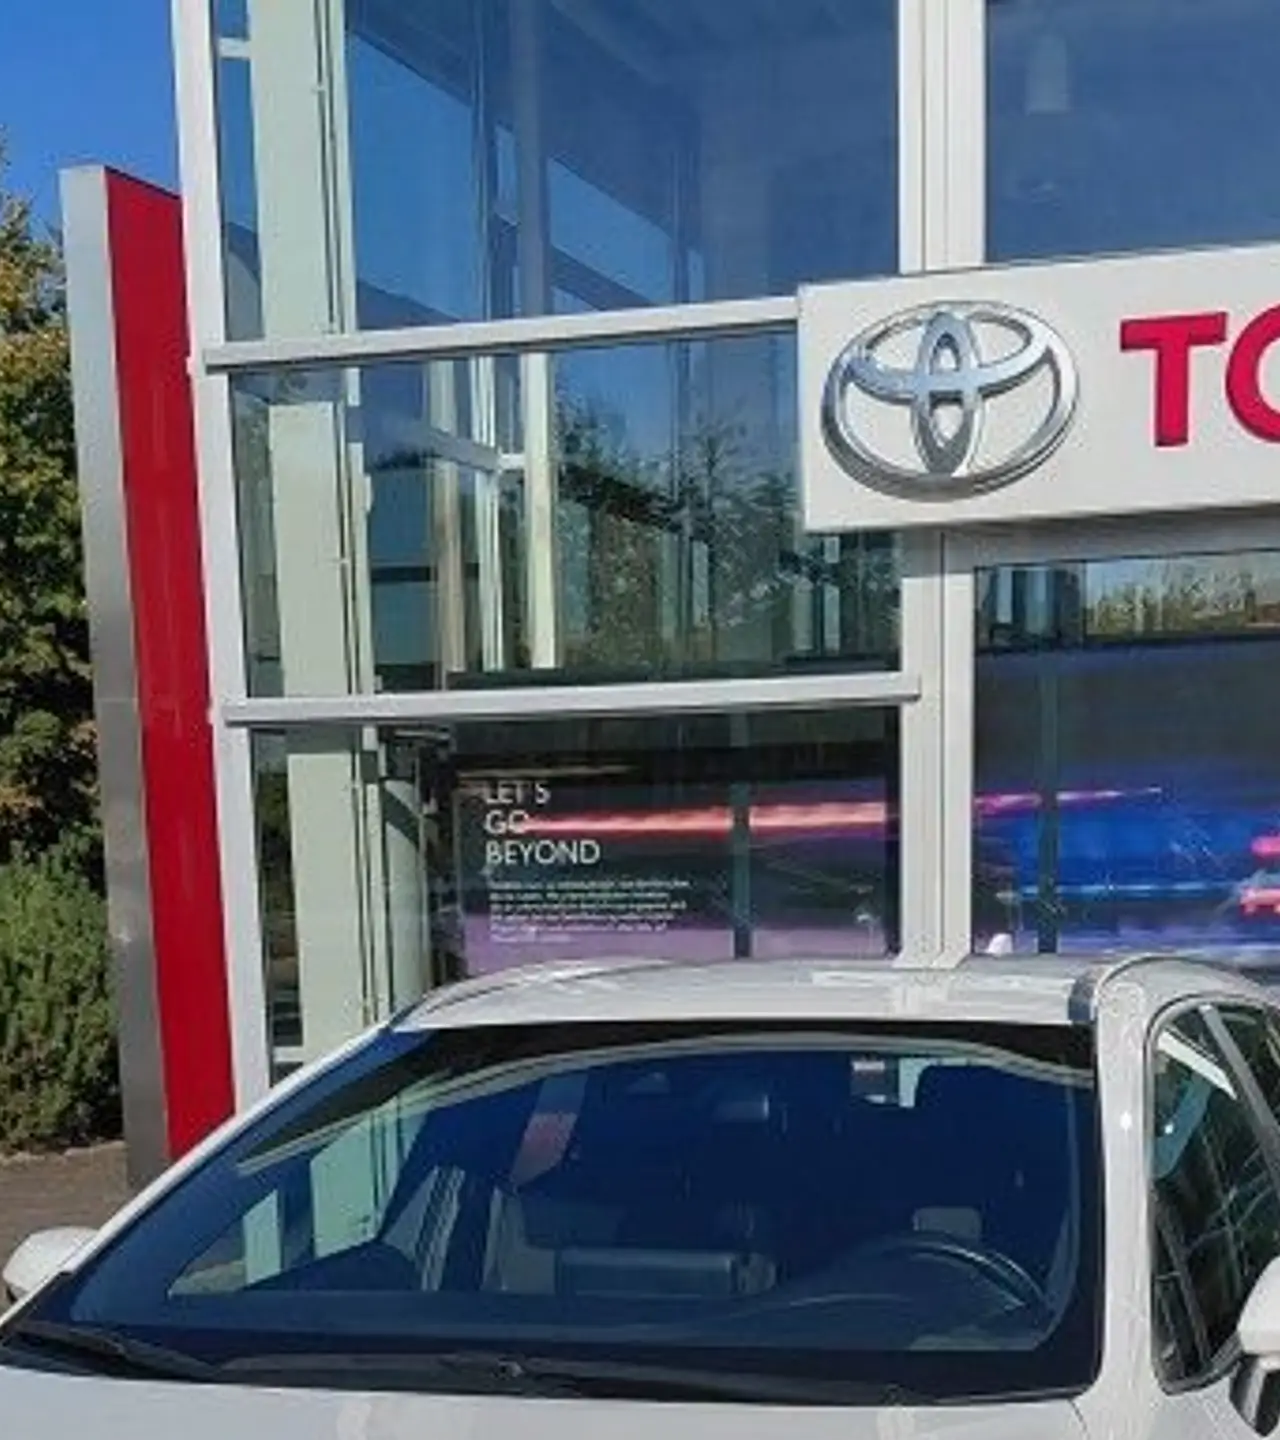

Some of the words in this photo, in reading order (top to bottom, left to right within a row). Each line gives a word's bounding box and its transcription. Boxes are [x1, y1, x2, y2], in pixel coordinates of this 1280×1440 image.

[485, 778, 552, 804] LET'S
[484, 808, 531, 835] GO
[485, 838, 601, 866] BEYOND
